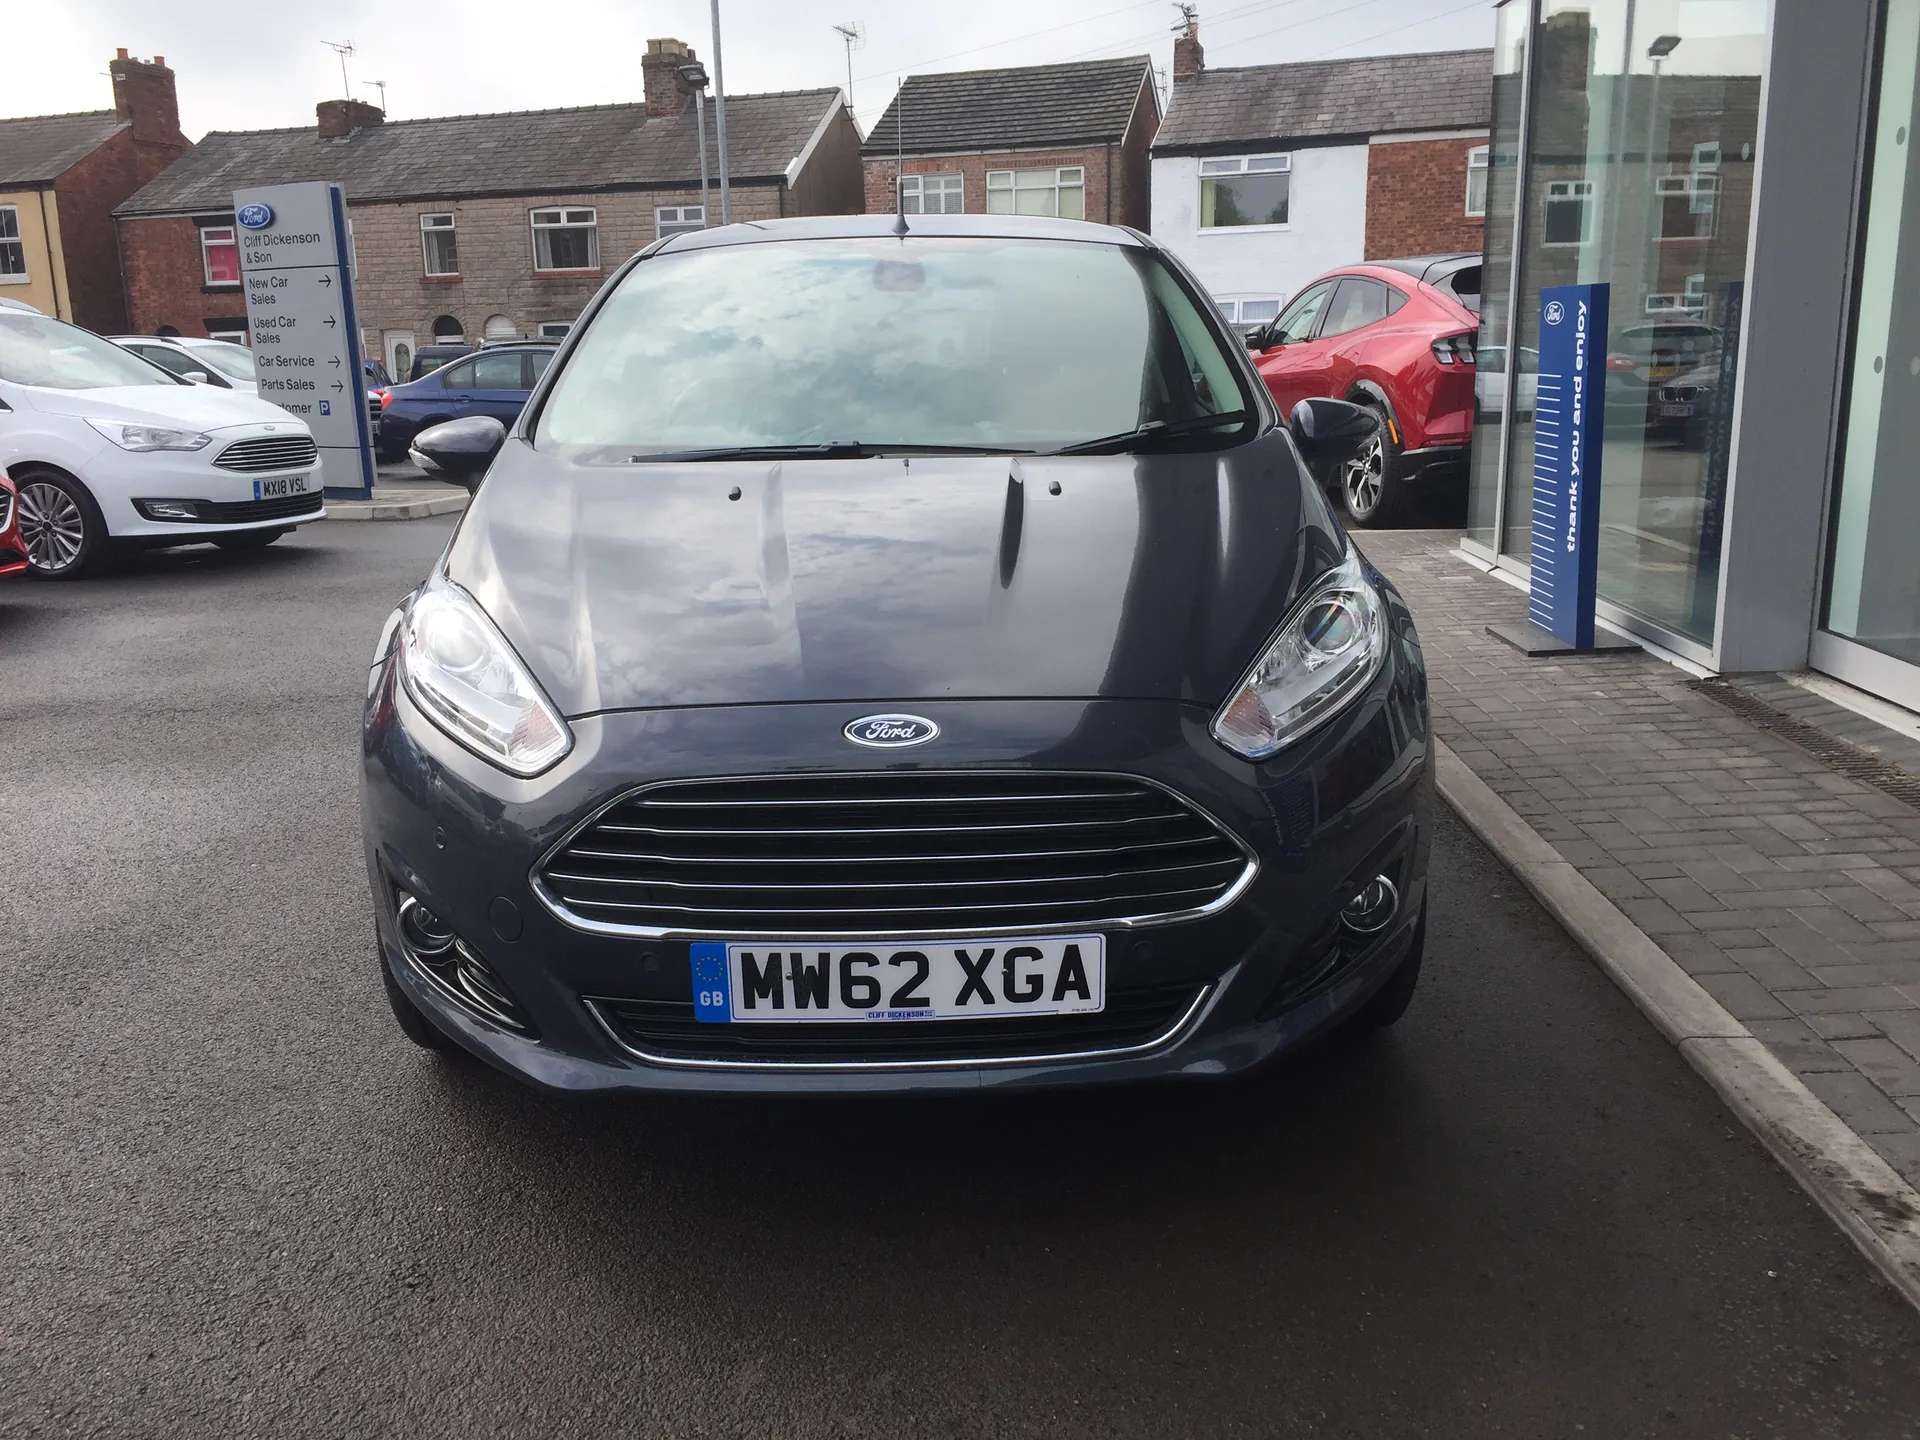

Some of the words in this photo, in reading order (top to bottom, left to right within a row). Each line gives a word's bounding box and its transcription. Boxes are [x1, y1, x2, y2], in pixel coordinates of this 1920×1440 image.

[244, 207, 264, 224] Ford
[244, 235, 262, 248] Cliff
[263, 232, 321, 246] Dickenson
[246, 255, 253, 264] &
[254, 251, 272, 263] Son
[249, 278, 269, 289] New
[271, 276, 288, 288] Car
[251, 293, 276, 305] Sales
[254, 317, 276, 329] Used
[278, 315, 296, 328] Car
[256, 333, 281, 344] Sales
[1576, 300, 1587, 371] enjoy
[258, 355, 275, 367] Car
[275, 354, 315, 367] Service
[261, 378, 284, 390] Parts
[286, 378, 315, 391] Sales
[1573, 376, 1582, 425] and
[1571, 430, 1580, 476] you
[263, 479, 287, 497] MX18
[288, 477, 307, 493] VSL
[1567, 480, 1578, 552] thank
[866, 720, 917, 739] Ford
[740, 951, 931, 1010] MW62
[954, 944, 1092, 1006] XGA
[700, 991, 724, 1006] GB
